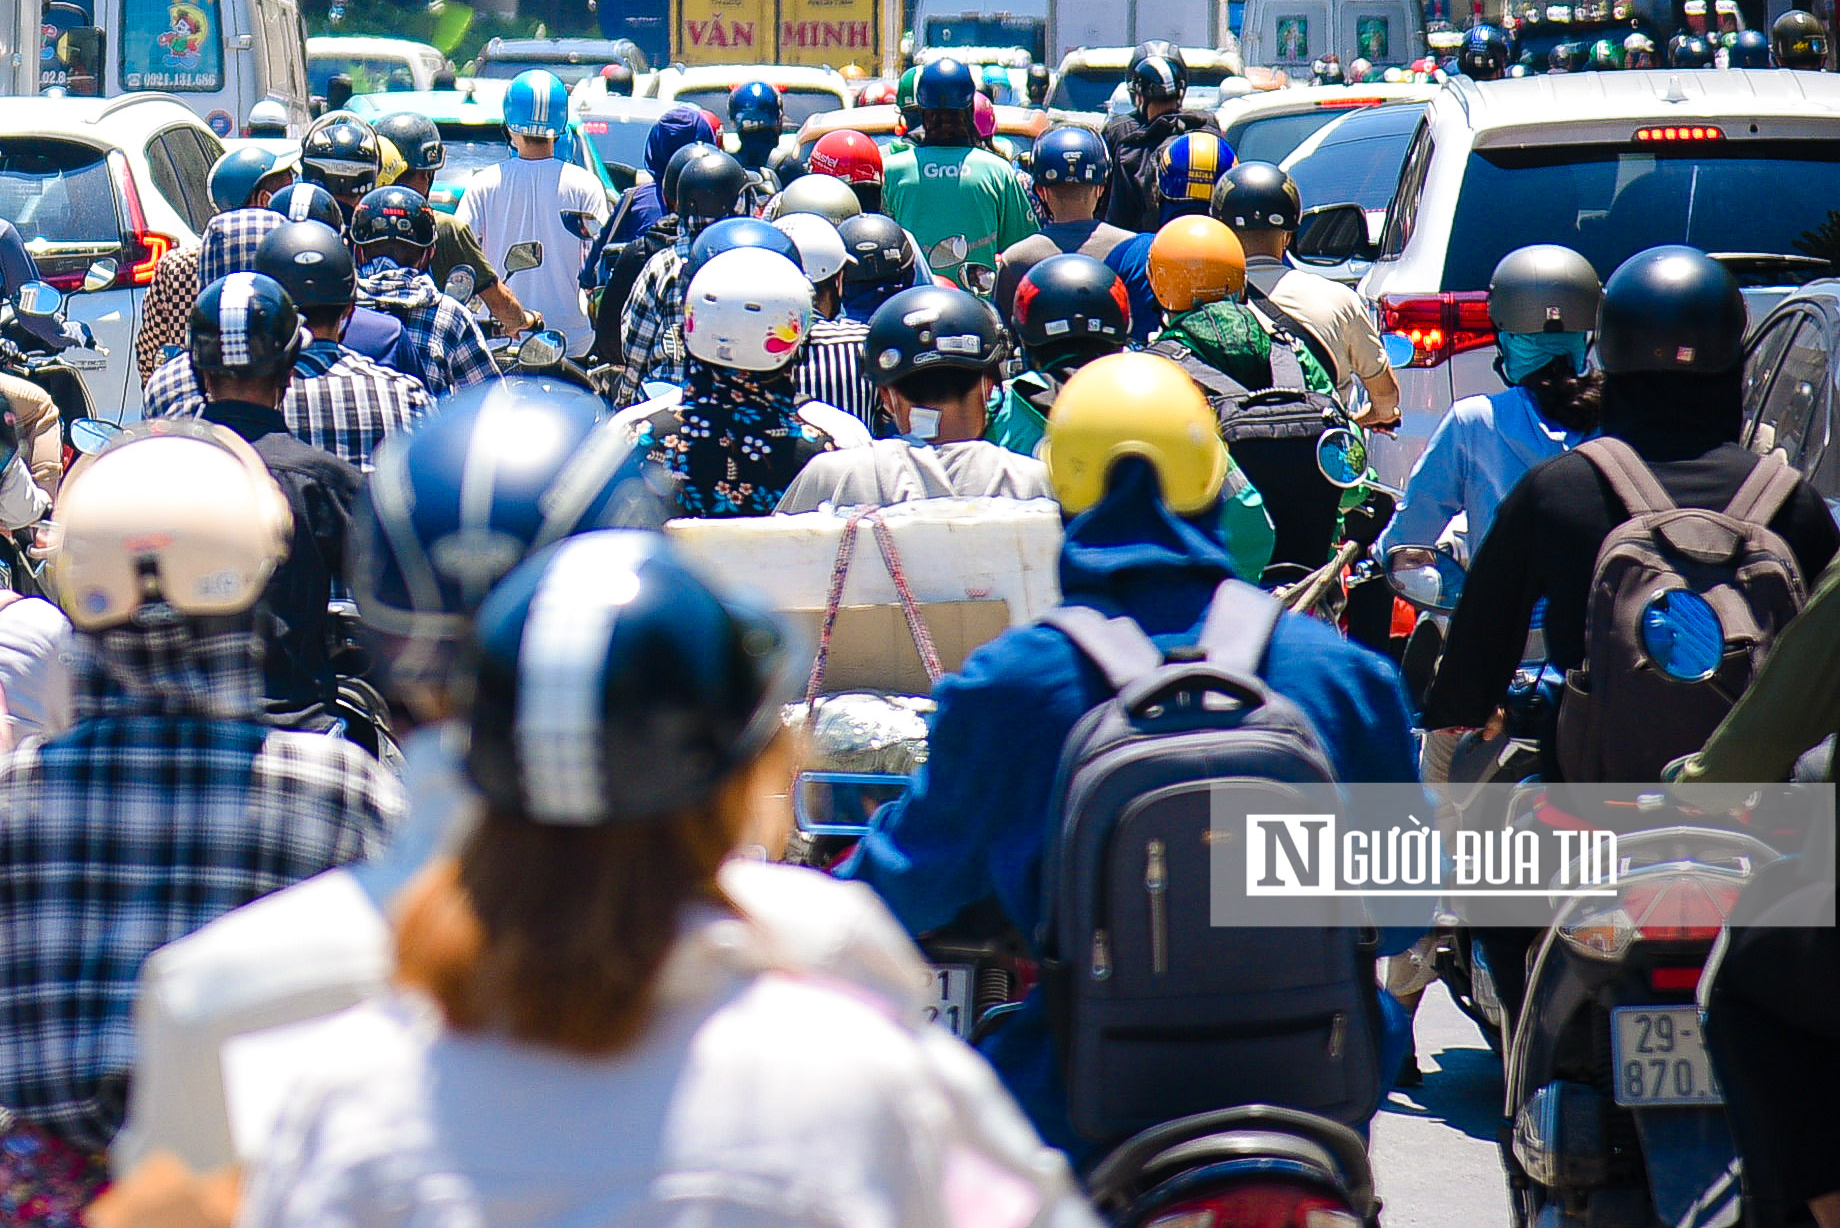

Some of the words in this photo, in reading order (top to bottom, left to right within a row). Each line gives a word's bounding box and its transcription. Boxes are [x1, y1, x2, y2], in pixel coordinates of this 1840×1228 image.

[686, 12, 755, 47] VĂN
[781, 20, 871, 47] MINH
[923, 161, 972, 179] Grab
